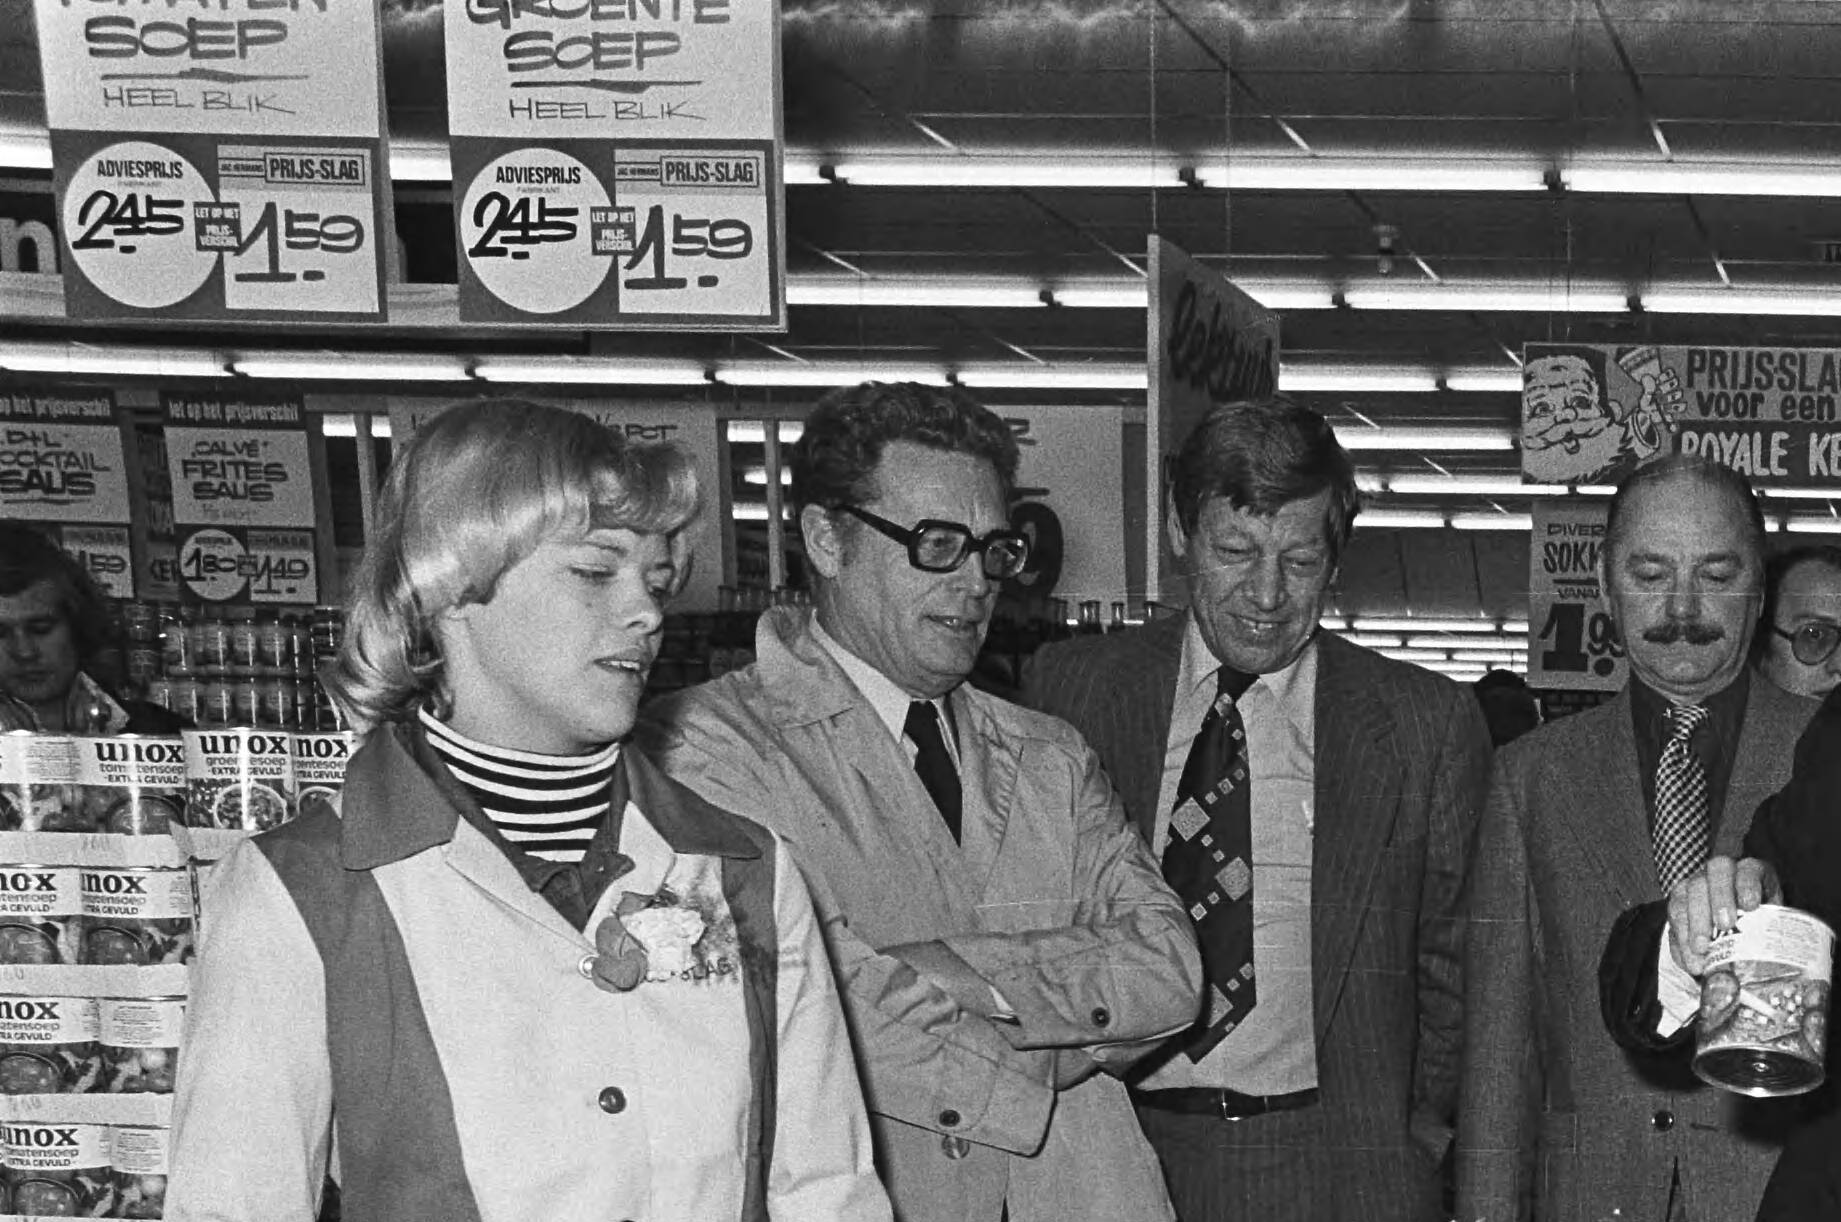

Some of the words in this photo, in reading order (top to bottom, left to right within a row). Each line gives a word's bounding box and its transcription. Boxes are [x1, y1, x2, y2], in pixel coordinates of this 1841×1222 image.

[85, 16, 289, 59] SOEP
[503, 30, 682, 71] SOEP
[103, 87, 195, 110] HEEL
[202, 90, 296, 114] BLIK
[509, 98, 606, 120] HEEL
[613, 100, 707, 120] BLIK
[96, 159, 184, 179] ADVIESPRIJS
[269, 158, 360, 180] PRIJS-SLAG
[496, 165, 581, 185] ADVIESPRIJS
[665, 161, 754, 183] PRIJS-SLAG
[1698, 391, 1764, 419] voor
[1779, 393, 1837, 422] een
[181, 459, 289, 482] FRITES
[192, 481, 275, 502] SAUS
[199, 733, 289, 755] unox
[296, 738, 348, 758] nox
[0, 1000, 60, 1020] nox
